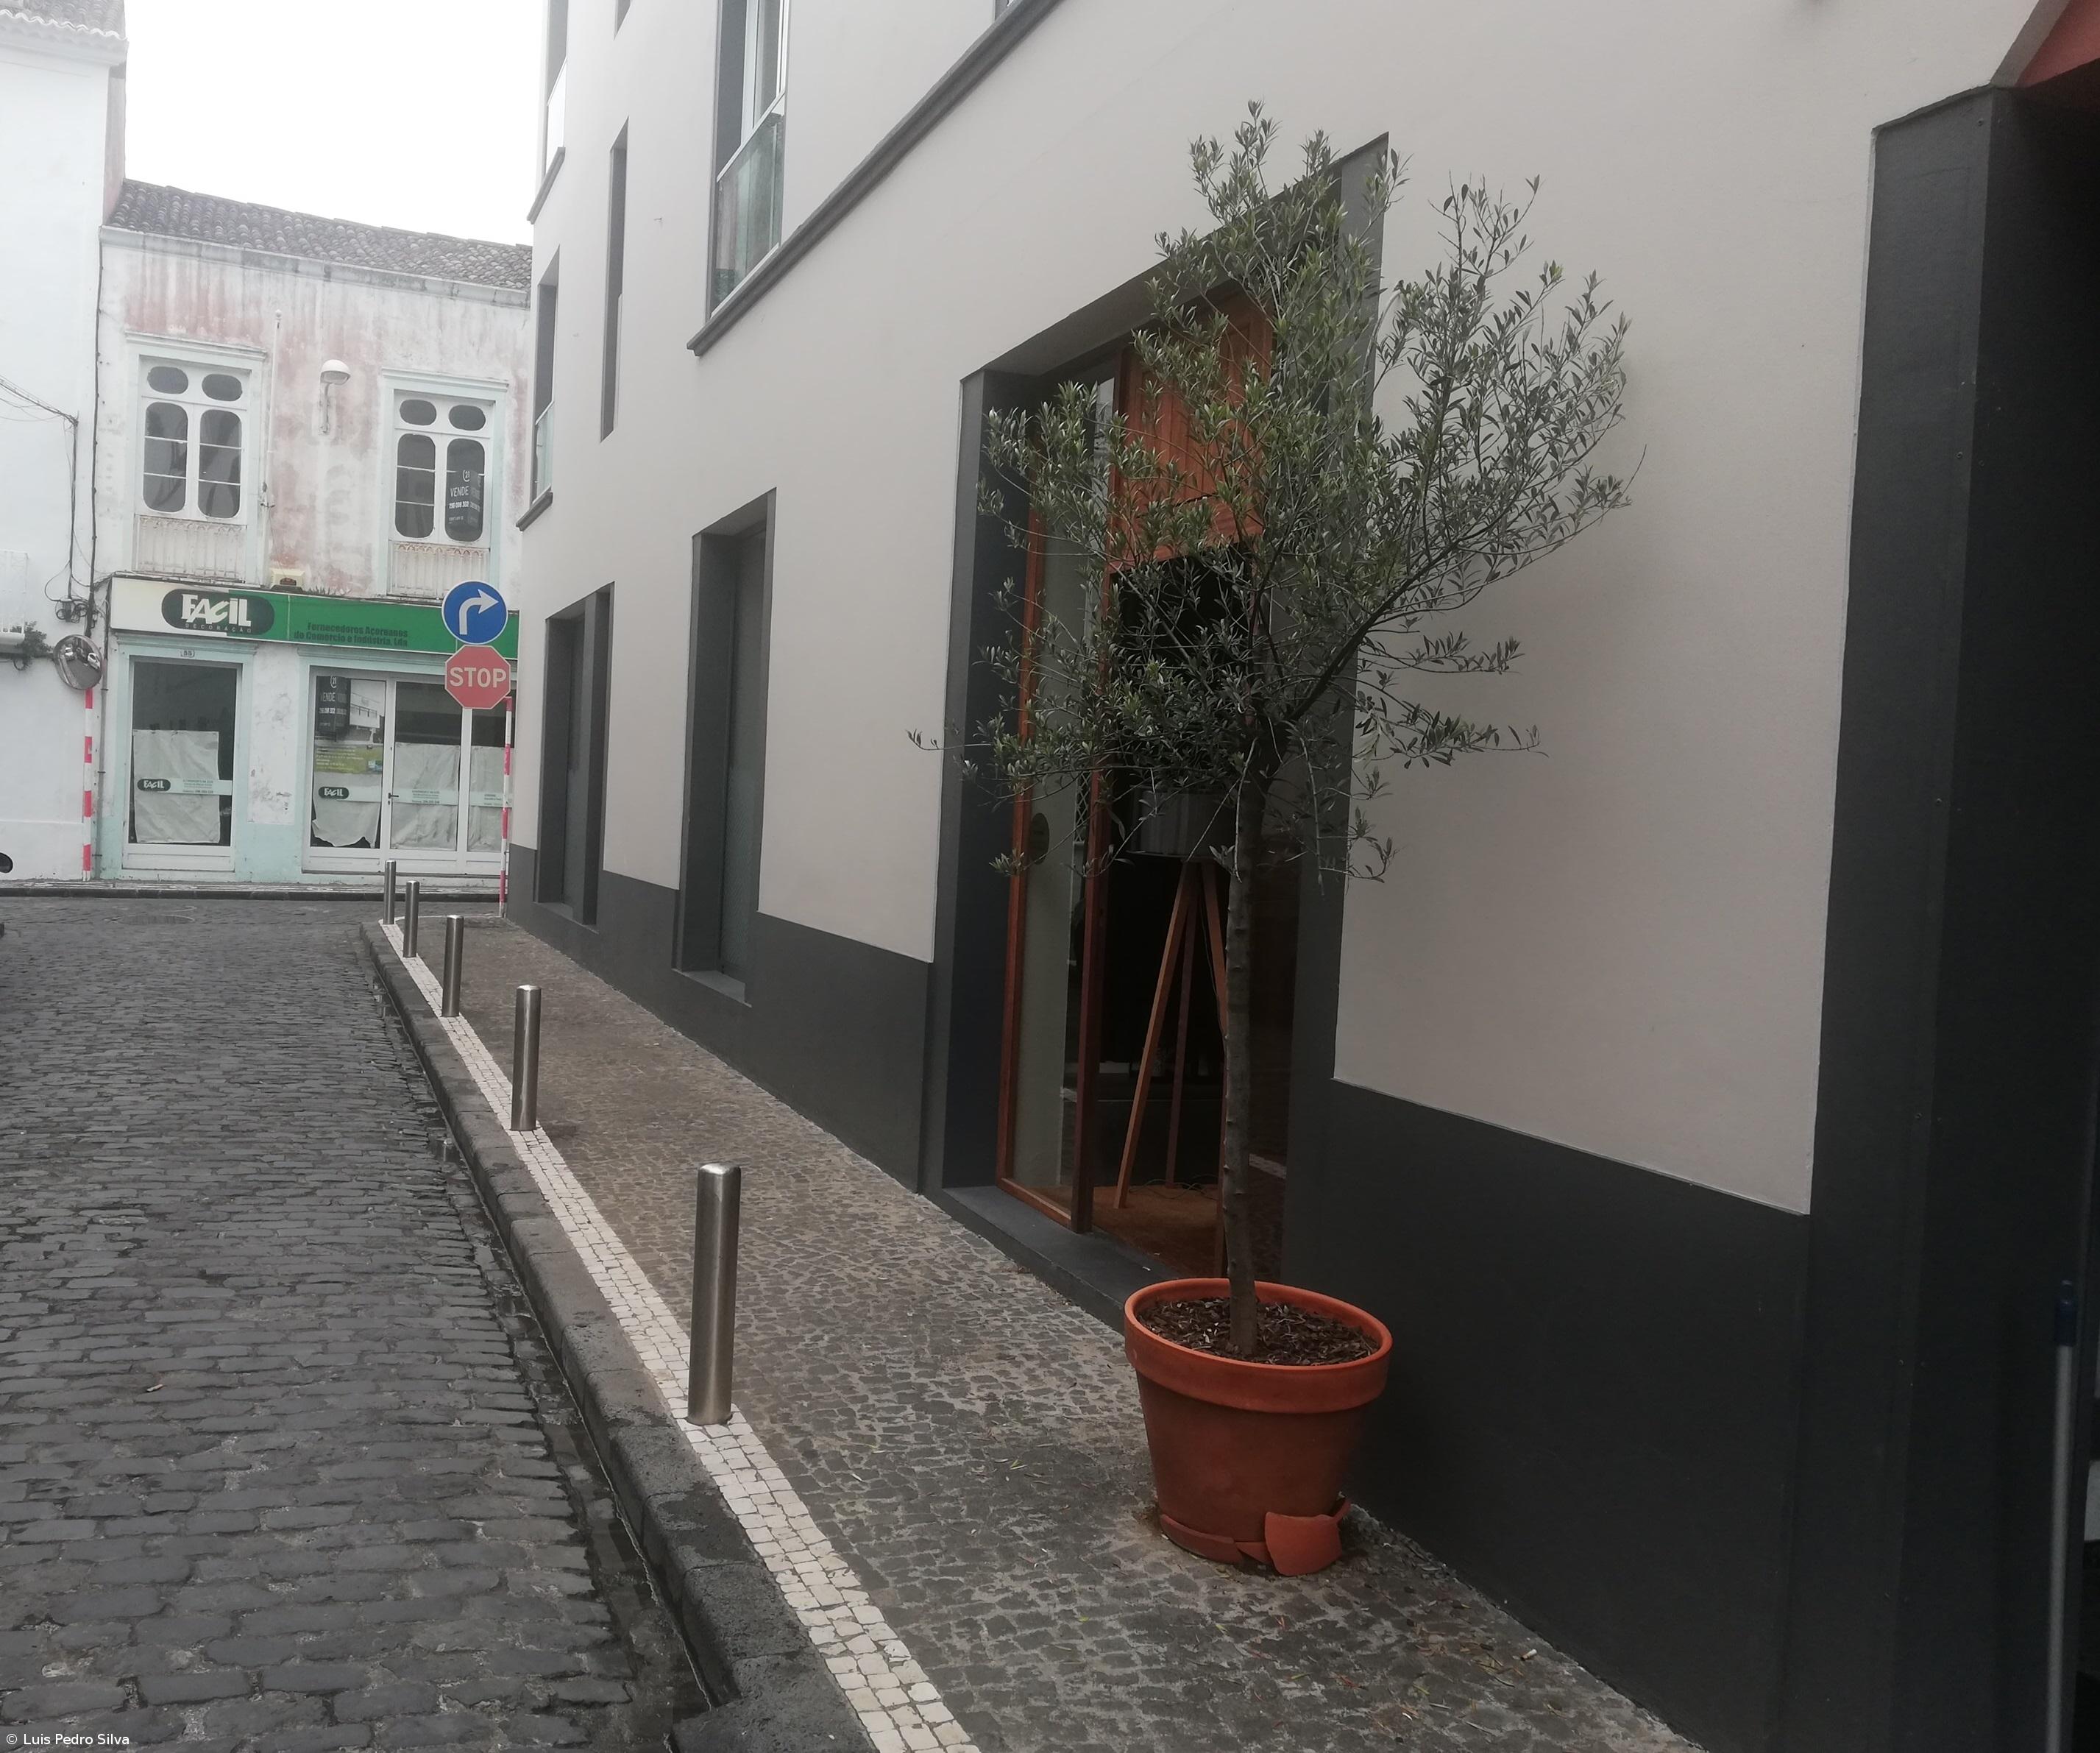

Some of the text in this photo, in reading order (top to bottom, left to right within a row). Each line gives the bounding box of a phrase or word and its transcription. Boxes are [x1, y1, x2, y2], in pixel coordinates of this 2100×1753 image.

[450, 486, 469, 497] VENDE
[308, 623, 364, 634] Fornecedores
[450, 667, 507, 688] STOP
[320, 692, 336, 701] ENDE
